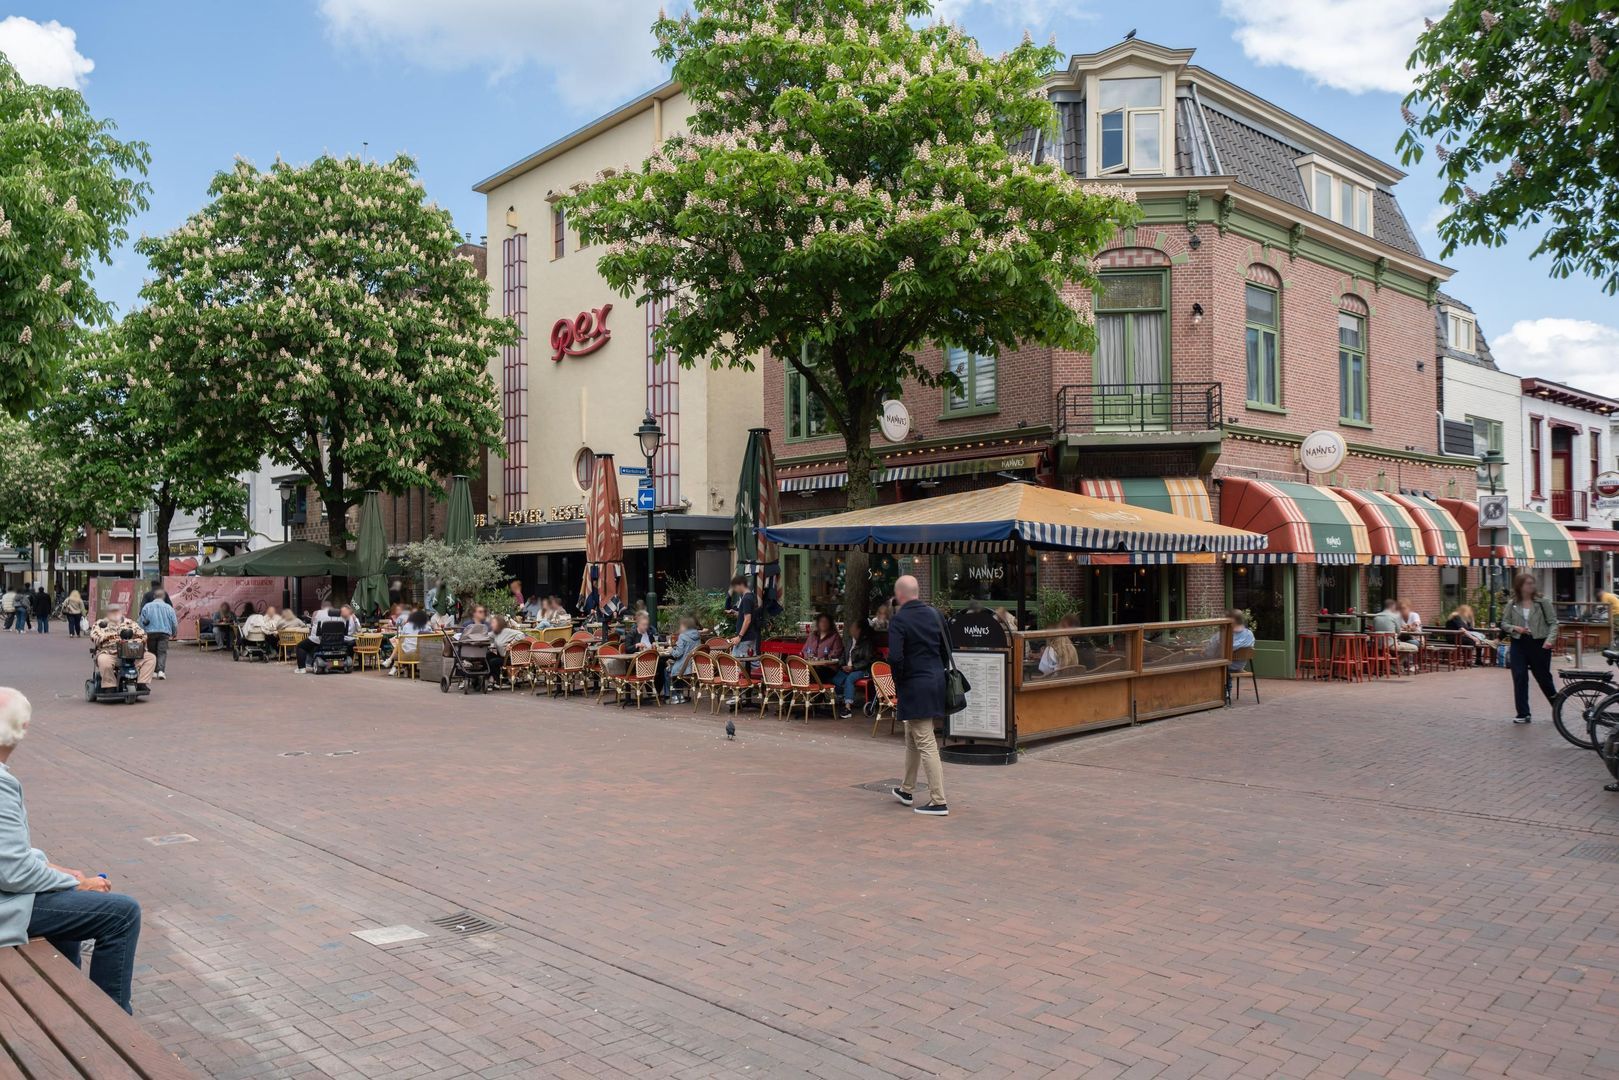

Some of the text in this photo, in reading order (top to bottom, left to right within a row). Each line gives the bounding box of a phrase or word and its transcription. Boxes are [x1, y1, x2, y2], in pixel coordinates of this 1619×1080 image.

[551, 304, 613, 361] Rex
[886, 414, 907, 426] NANNES
[1304, 444, 1337, 457] NANNES
[1001, 458, 1025, 468] NANNES
[508, 509, 543, 525] FOYER
[968, 564, 1004, 579] NANNES
[964, 625, 990, 636] NANNES
